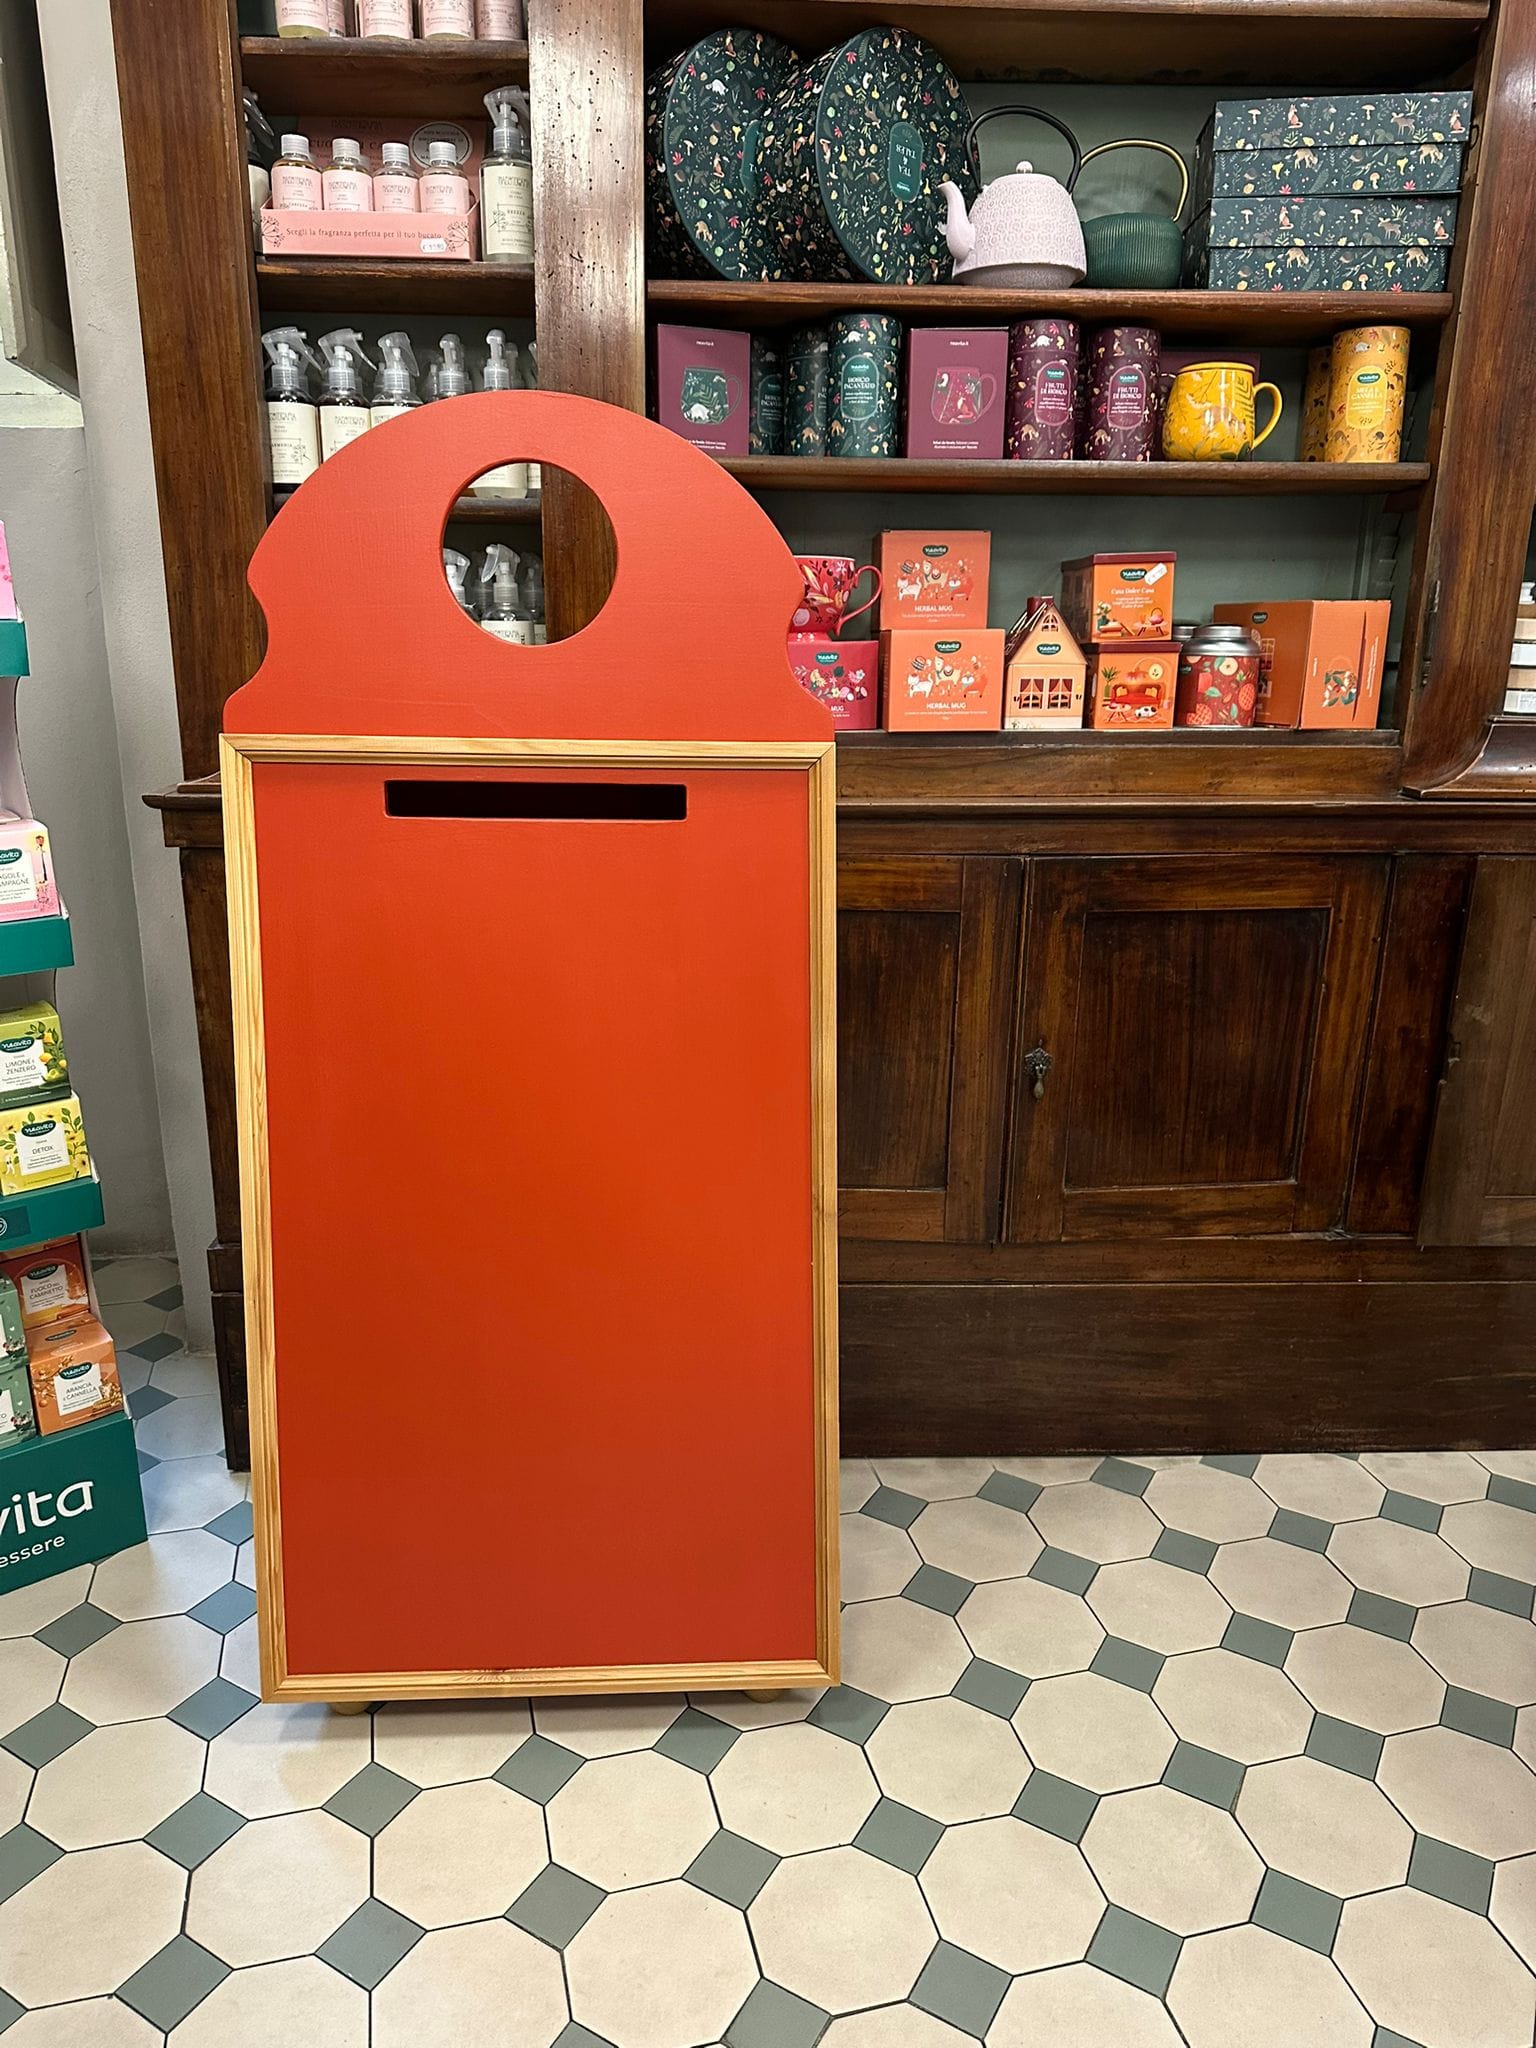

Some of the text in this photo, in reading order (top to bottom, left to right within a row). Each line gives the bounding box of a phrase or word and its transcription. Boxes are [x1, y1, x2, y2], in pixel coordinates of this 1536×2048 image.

[898, 164, 911, 177] TEA
[286, 228, 308, 237] Scegli
[309, 228, 316, 236] la
[318, 229, 351, 239] fragranza
[353, 229, 381, 239] perfetta
[383, 231, 395, 239] per
[403, 231, 416, 239] tuo
[417, 230, 443, 240] bucato
[5, 1058, 31, 1068] LIMONE
[6, 1064, 36, 1075] ZENZERO
[32, 1145, 54, 1155] DETOX
[65, 1382, 92, 1394] ARANCIA
[66, 1386, 97, 1400] CANNELLA
